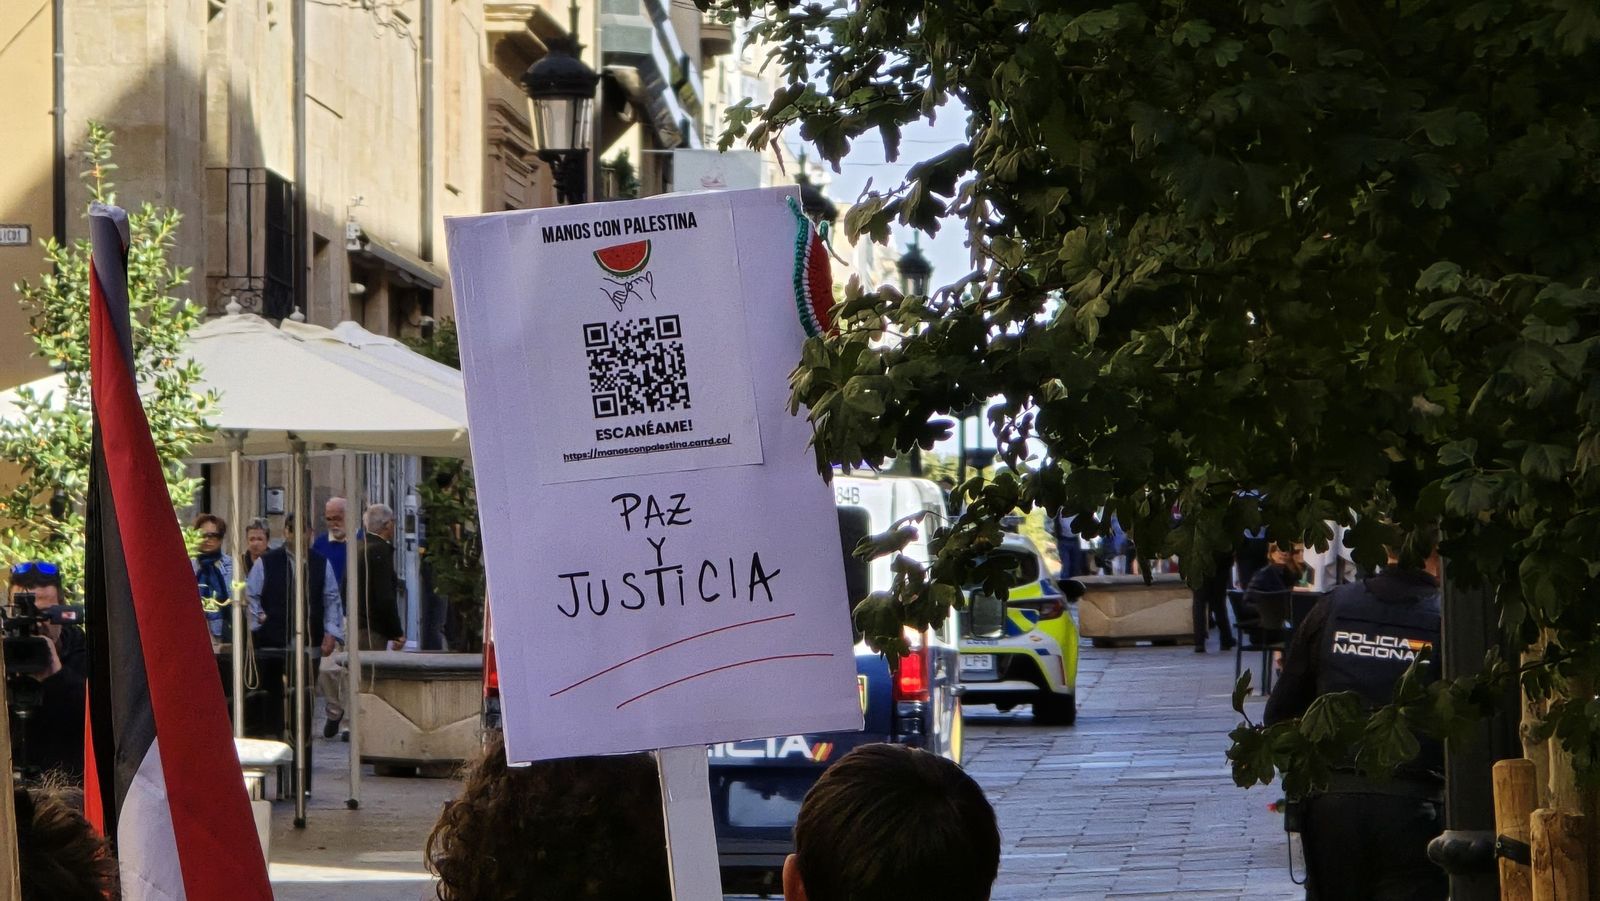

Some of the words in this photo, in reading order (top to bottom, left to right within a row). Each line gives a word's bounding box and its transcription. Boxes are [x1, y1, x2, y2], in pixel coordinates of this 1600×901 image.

[542, 222, 591, 244] MANOS
[593, 218, 621, 238] CON
[624, 211, 698, 235] PALESTINA
[595, 419, 694, 442] ESCANÉAME!
[563, 433, 732, 463] https://manosconpalestina.carrd.co/
[611, 493, 692, 532] PAZ
[646, 536, 666, 567] Y
[1334, 631, 1411, 649] POLICIA
[1333, 643, 1430, 664] NACIONA
[708, 735, 814, 758] ICIA
